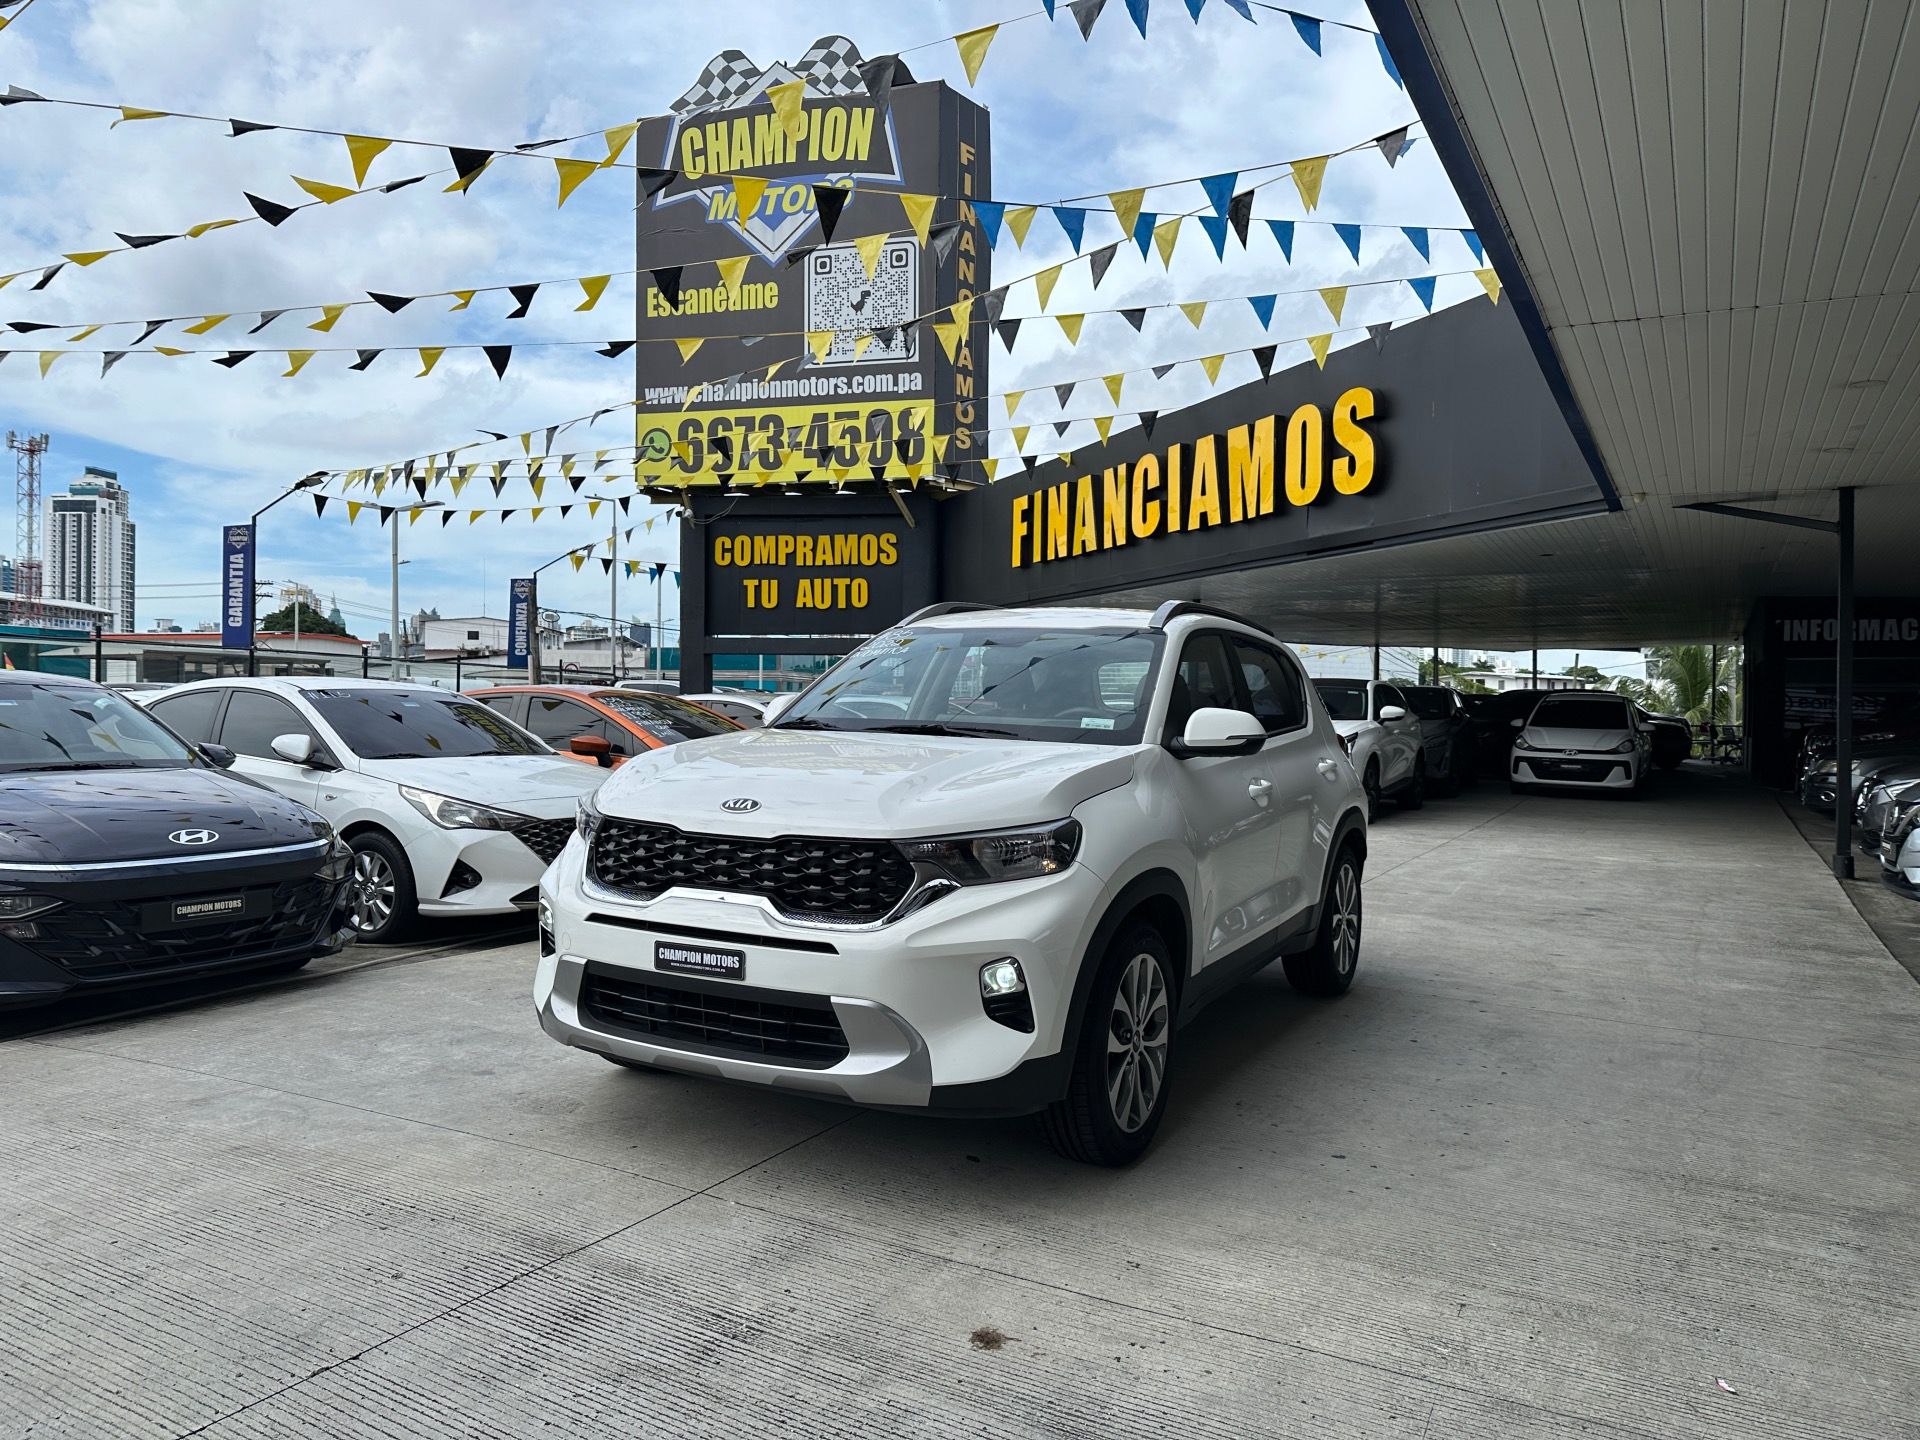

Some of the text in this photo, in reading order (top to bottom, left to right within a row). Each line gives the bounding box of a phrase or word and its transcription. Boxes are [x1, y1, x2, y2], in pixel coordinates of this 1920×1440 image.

[681, 106, 875, 180] CHAMPION
[708, 178, 854, 221] MTO
[955, 141, 976, 450] FINANCAMOS
[644, 372, 923, 405] wwwchampionmotors.com.pa
[1011, 386, 1376, 568] FINANCIAMOS
[714, 533, 898, 567] COMPRAMOS
[228, 553, 244, 627] GARANTIA
[743, 577, 869, 609] TU AUTO
[515, 602, 528, 656] CONFIANZA
[1783, 618, 1919, 642] INFOMAC
[724, 799, 753, 810] KIA
[176, 902, 213, 915] CHAMPION
[214, 899, 242, 911] MOTORS
[658, 947, 740, 969] CHAMPION MOTORS
